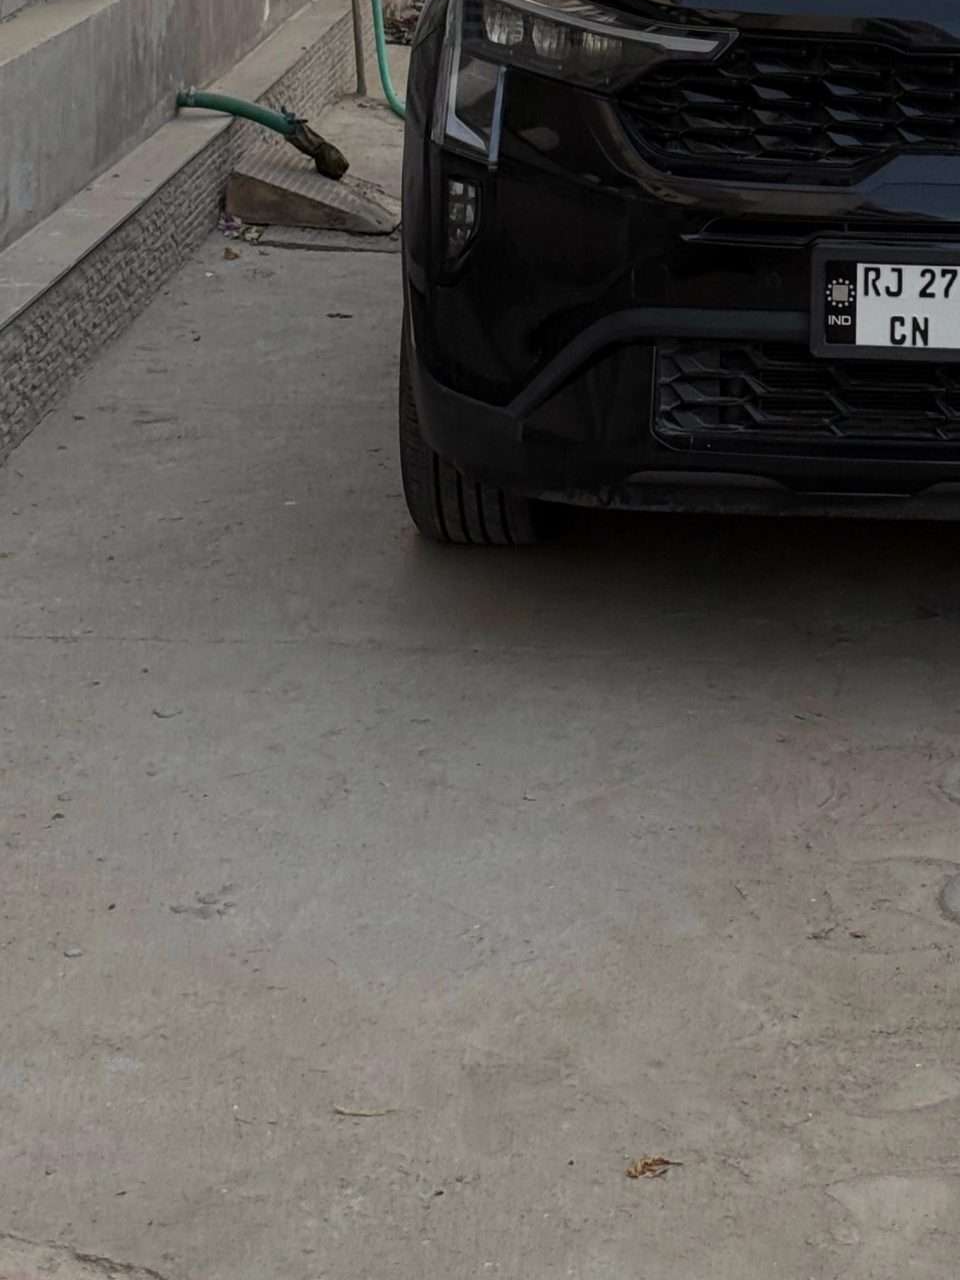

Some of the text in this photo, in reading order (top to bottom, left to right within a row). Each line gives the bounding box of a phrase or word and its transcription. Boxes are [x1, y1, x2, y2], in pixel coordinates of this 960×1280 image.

[863, 267, 958, 298] RJ 27
[828, 315, 851, 326] IND
[889, 316, 929, 346] CN
